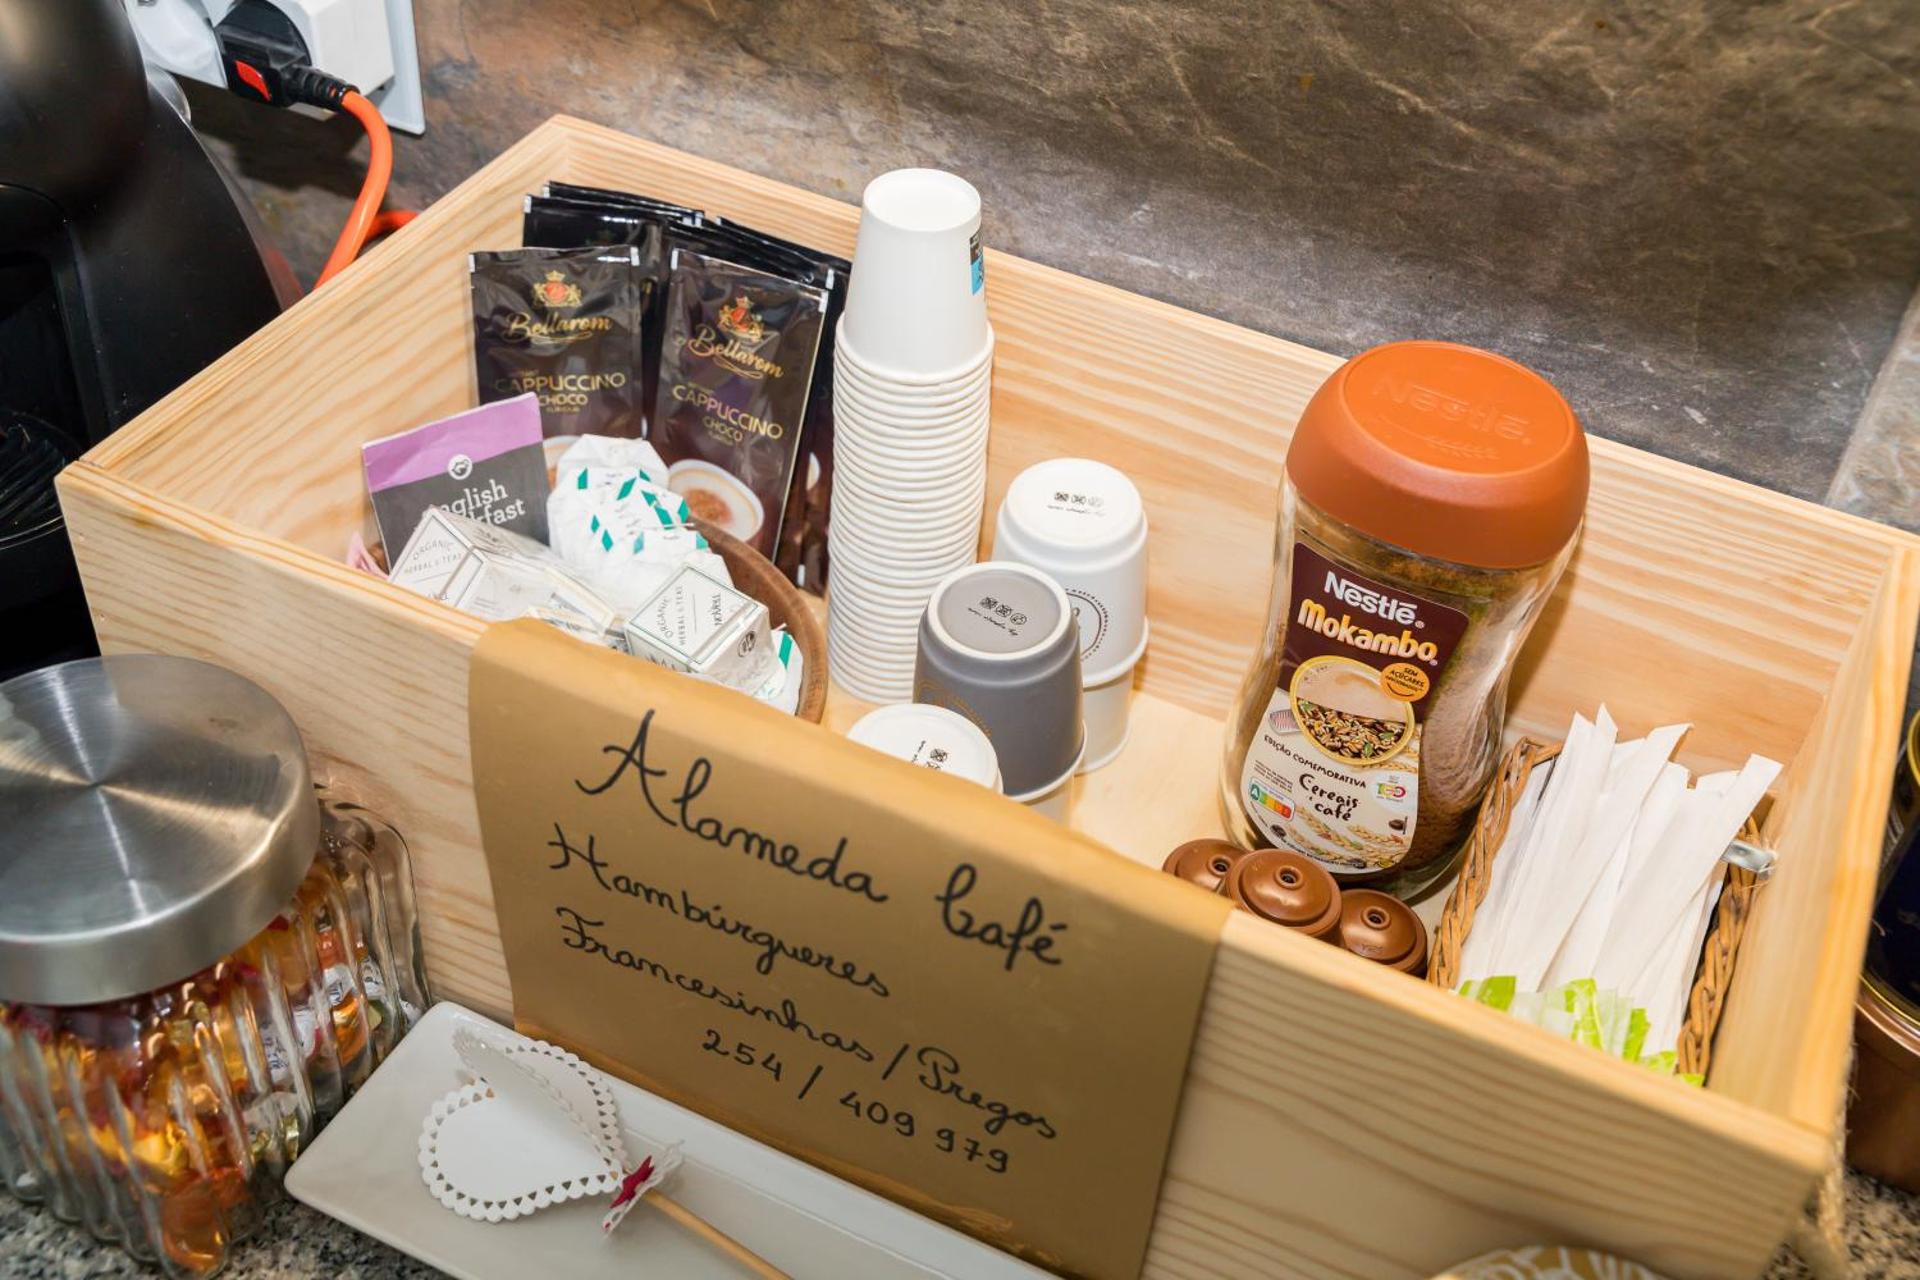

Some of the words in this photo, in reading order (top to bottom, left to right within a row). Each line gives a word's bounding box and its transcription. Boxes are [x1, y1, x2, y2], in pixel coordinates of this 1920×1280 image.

[501, 311, 613, 343] Bellarom
[688, 323, 784, 379] Bellarom
[495, 372, 626, 393] CAPPUCCINO
[671, 384, 783, 439] CAPPUCCINO
[703, 415, 744, 442] CHOCO
[1264, 733, 1292, 757] EDIÇÃO
[1292, 753, 1367, 789] COMEMORATIVA
[1298, 772, 1360, 809] Cereais
[1314, 802, 1353, 821] café
[574, 708, 890, 903] Alameda
[936, 863, 1070, 971] Café
[547, 821, 890, 998] Hambúrgueres
[702, 1028, 784, 1082] 254
[839, 1091, 915, 1137] 409
[936, 1127, 1009, 1173] 979
